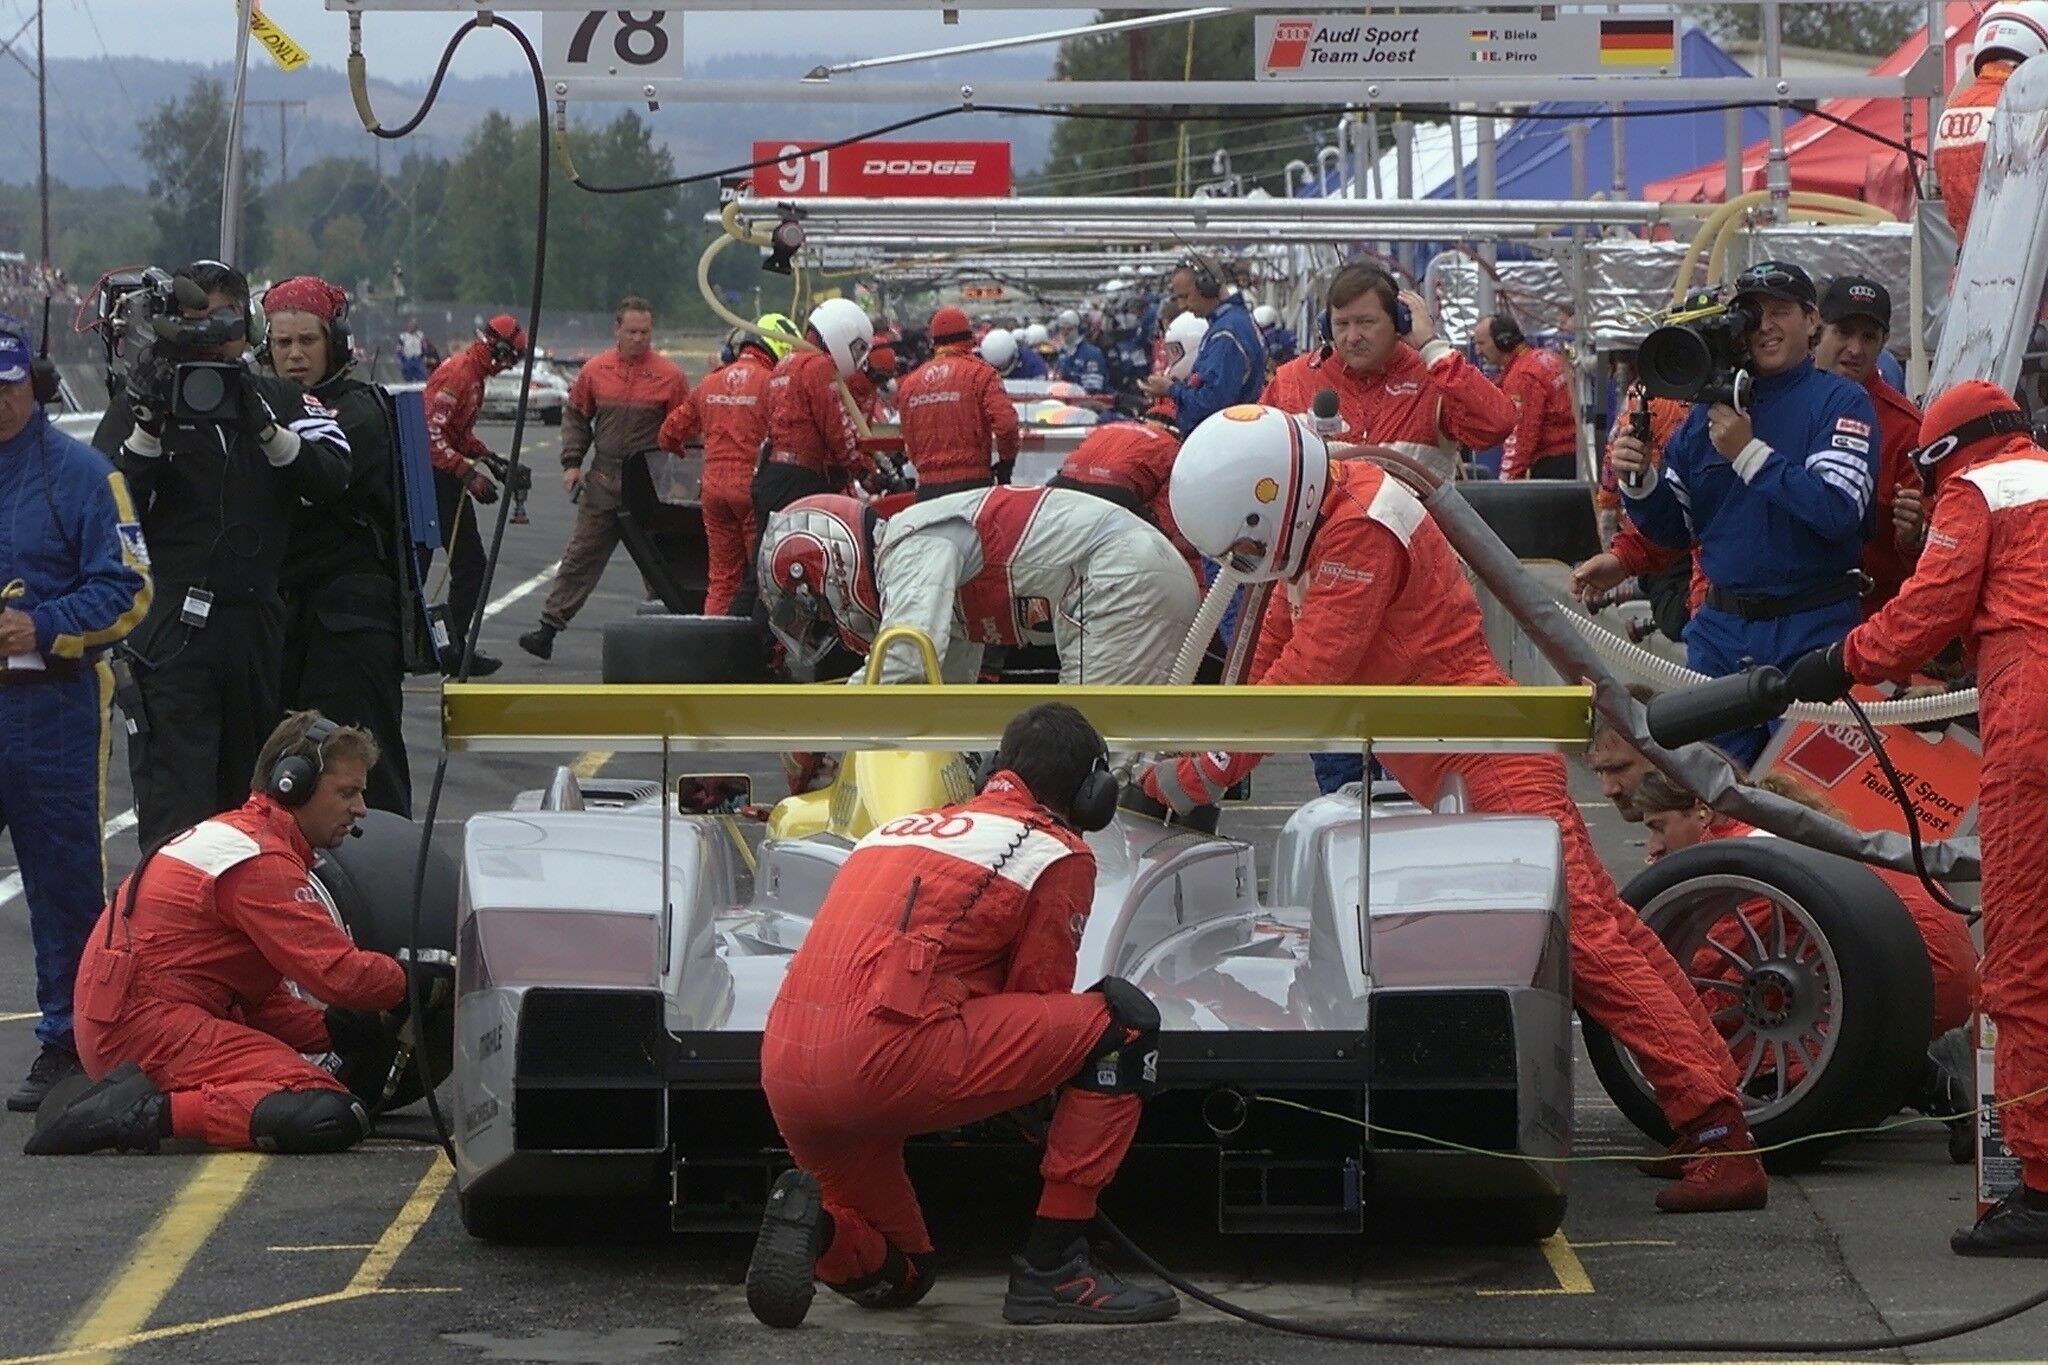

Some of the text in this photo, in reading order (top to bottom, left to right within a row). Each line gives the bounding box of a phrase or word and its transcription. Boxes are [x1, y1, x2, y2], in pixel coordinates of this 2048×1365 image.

[567, 10, 668, 65] 78
[1315, 27, 1419, 45] Audi Sport
[1490, 30, 1538, 40] F. Biela
[263, 34, 304, 65] ONLY
[1311, 48, 1416, 63] Team Joest
[1490, 51, 1538, 61] E. Pirro
[778, 144, 830, 193] 91
[862, 159, 977, 176] DODGE
[1915, 781, 1964, 817] Sport
